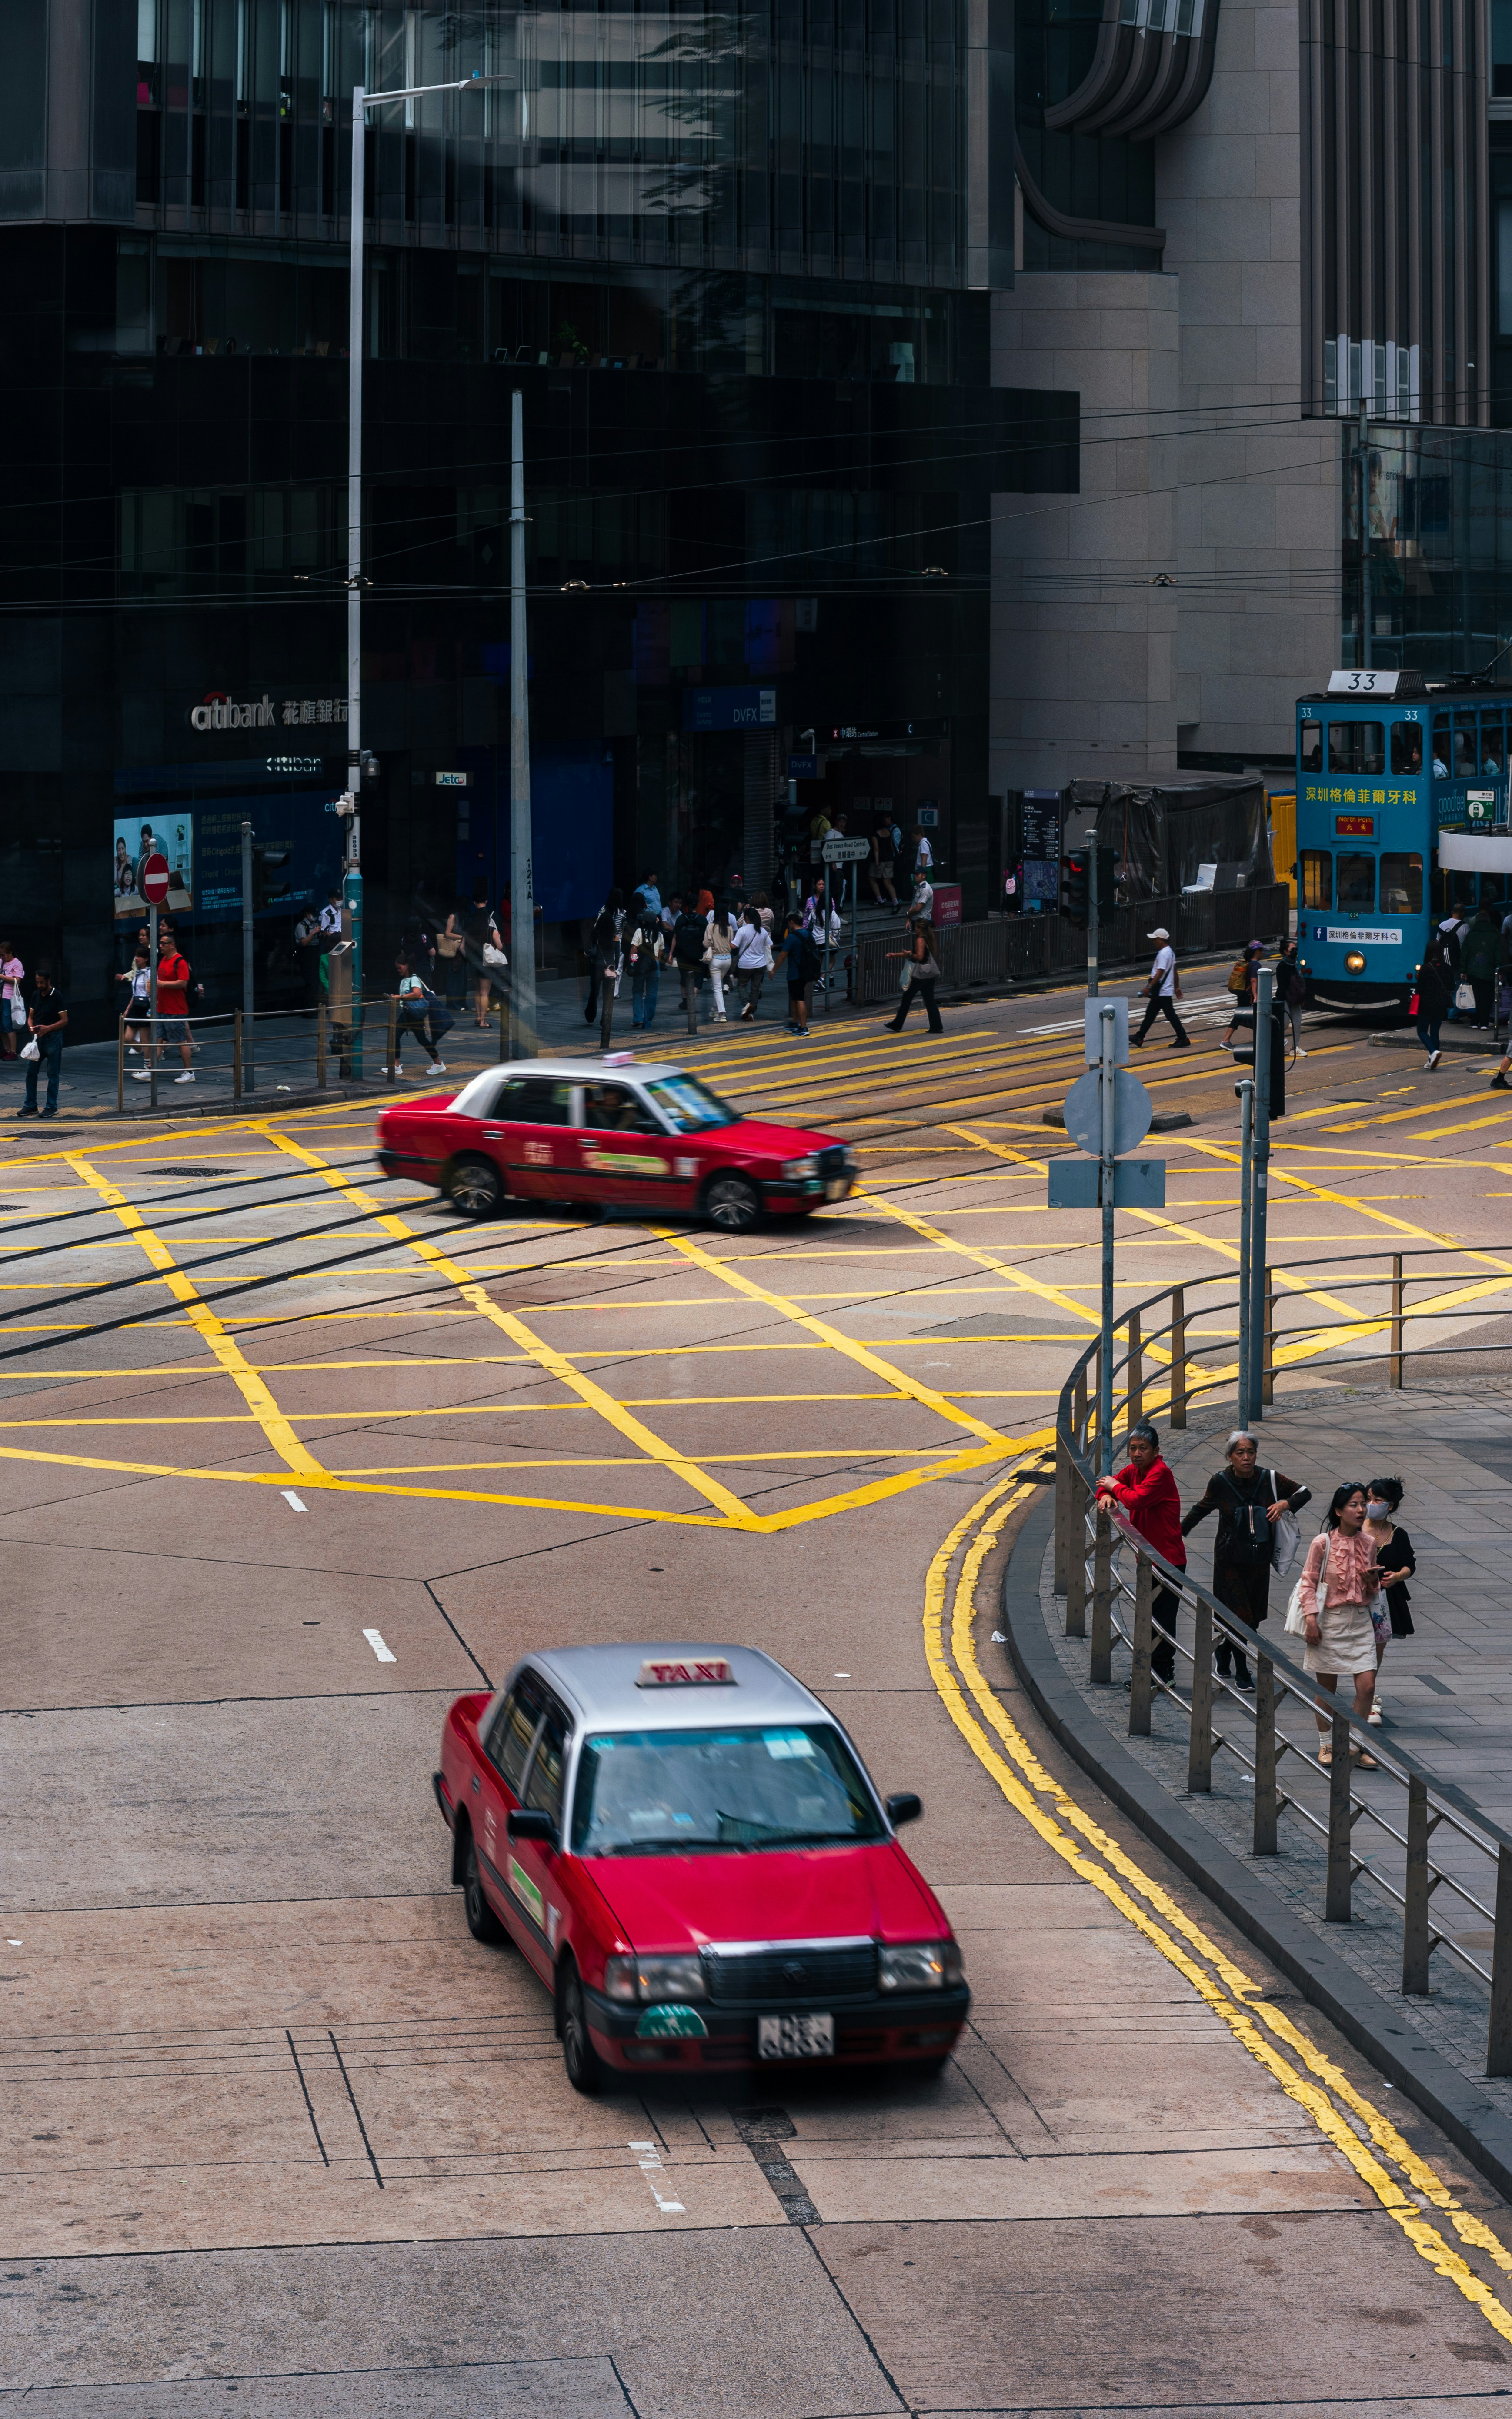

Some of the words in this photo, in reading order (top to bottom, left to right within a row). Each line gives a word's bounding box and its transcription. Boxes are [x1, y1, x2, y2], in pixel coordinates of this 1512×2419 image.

[1348, 673, 1377, 691] 33
[191, 691, 275, 730] citibank
[282, 698, 348, 725] 花旗銀行
[734, 707, 758, 722] DVFX
[1302, 708, 1312, 718] 33
[1405, 710, 1418, 721] 33
[840, 727, 857, 739] 中環站
[908, 724, 912, 733] C
[439, 774, 464, 784] Jetco
[1306, 787, 1416, 804] 深圳格倫菲爾牙科
[1439, 788, 1466, 822] goodfeel
[925, 813, 931, 822] C
[1328, 931, 1389, 940] 深圳格倫菲爾牙科
[651, 1662, 727, 1682] TAXI
